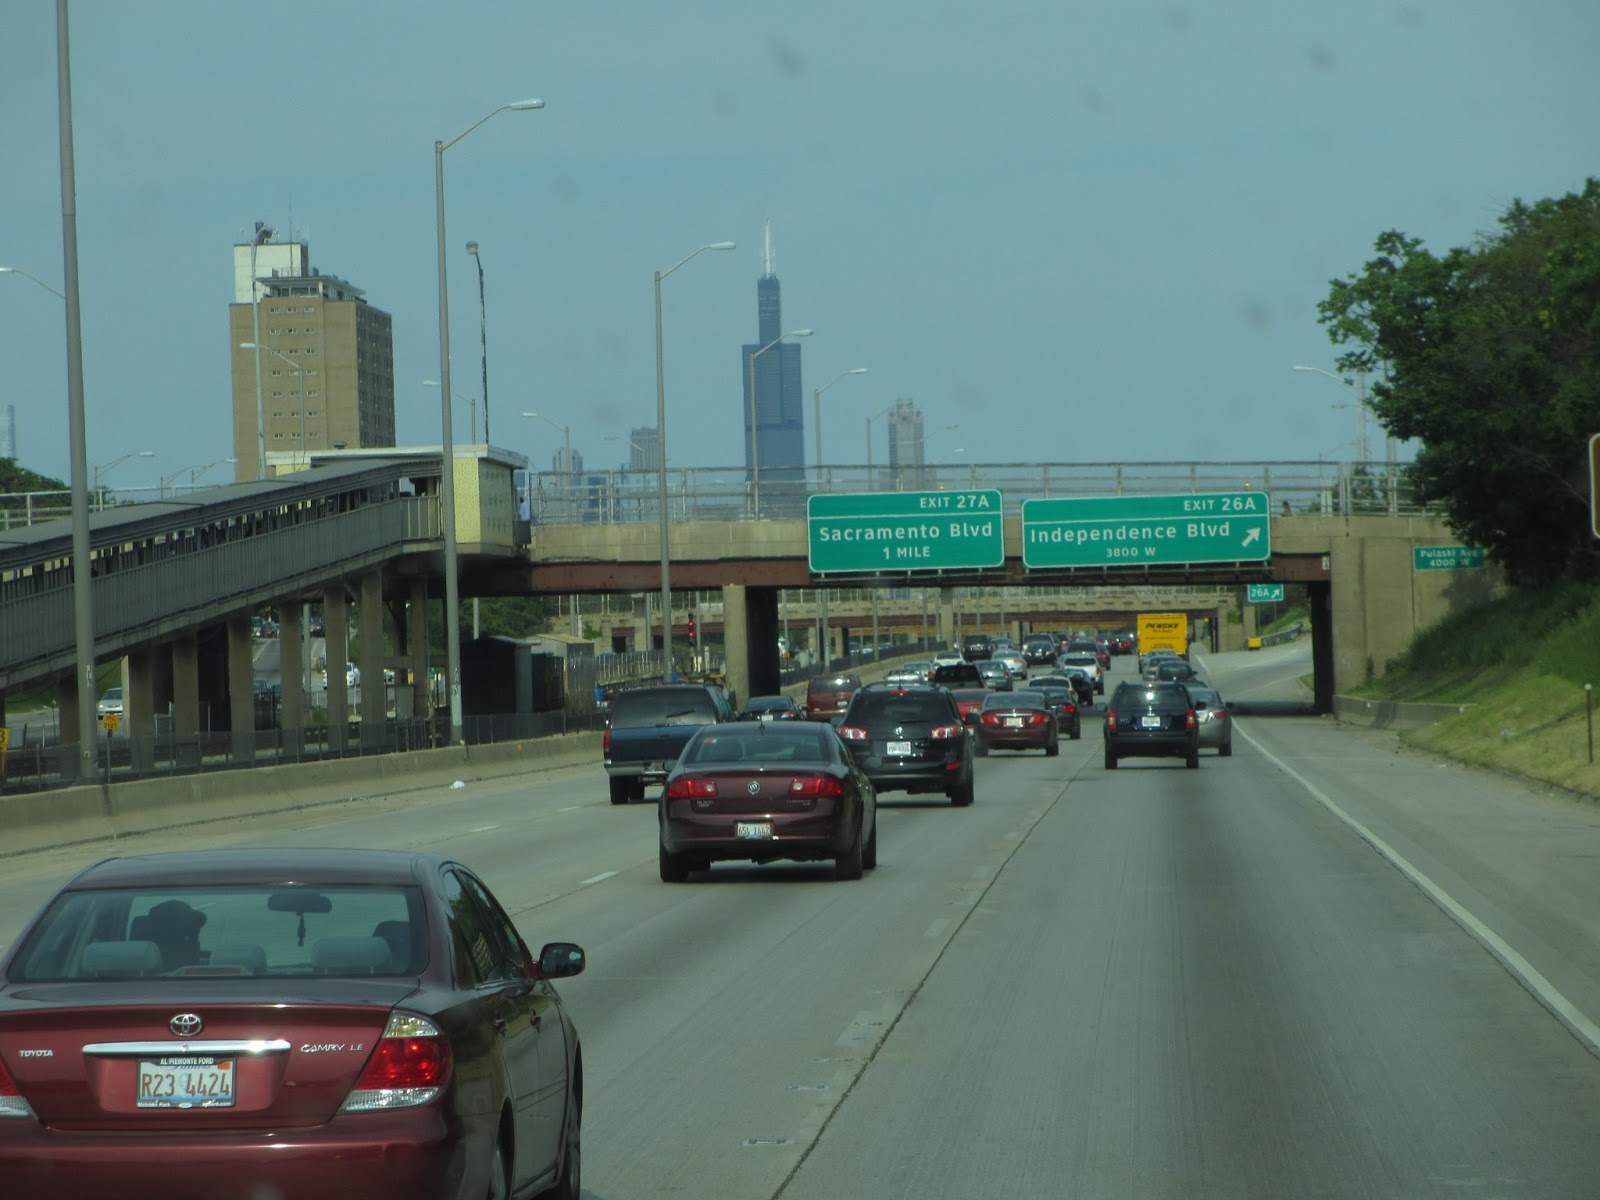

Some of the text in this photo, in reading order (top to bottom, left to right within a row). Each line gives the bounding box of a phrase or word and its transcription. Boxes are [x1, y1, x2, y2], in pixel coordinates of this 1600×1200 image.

[919, 495, 990, 509] EXIT 27A
[1183, 497, 1256, 511] EXIT 26A
[819, 522, 993, 542] Sacramento Blvd
[1030, 522, 1230, 545] Independence Blvd
[883, 546, 931, 559] 1 MILE
[1105, 547, 1156, 557] 3800 W
[1420, 548, 1456, 558] Pulaski
[1429, 558, 1471, 567] 4000 W
[1251, 588, 1270, 597] 26A
[19, 1049, 54, 1057] TOYOTA
[300, 1043, 364, 1053] CAMRY LE
[160, 1057, 214, 1065] AL PIEMONTE FORD
[141, 1072, 230, 1097] R23 4424
